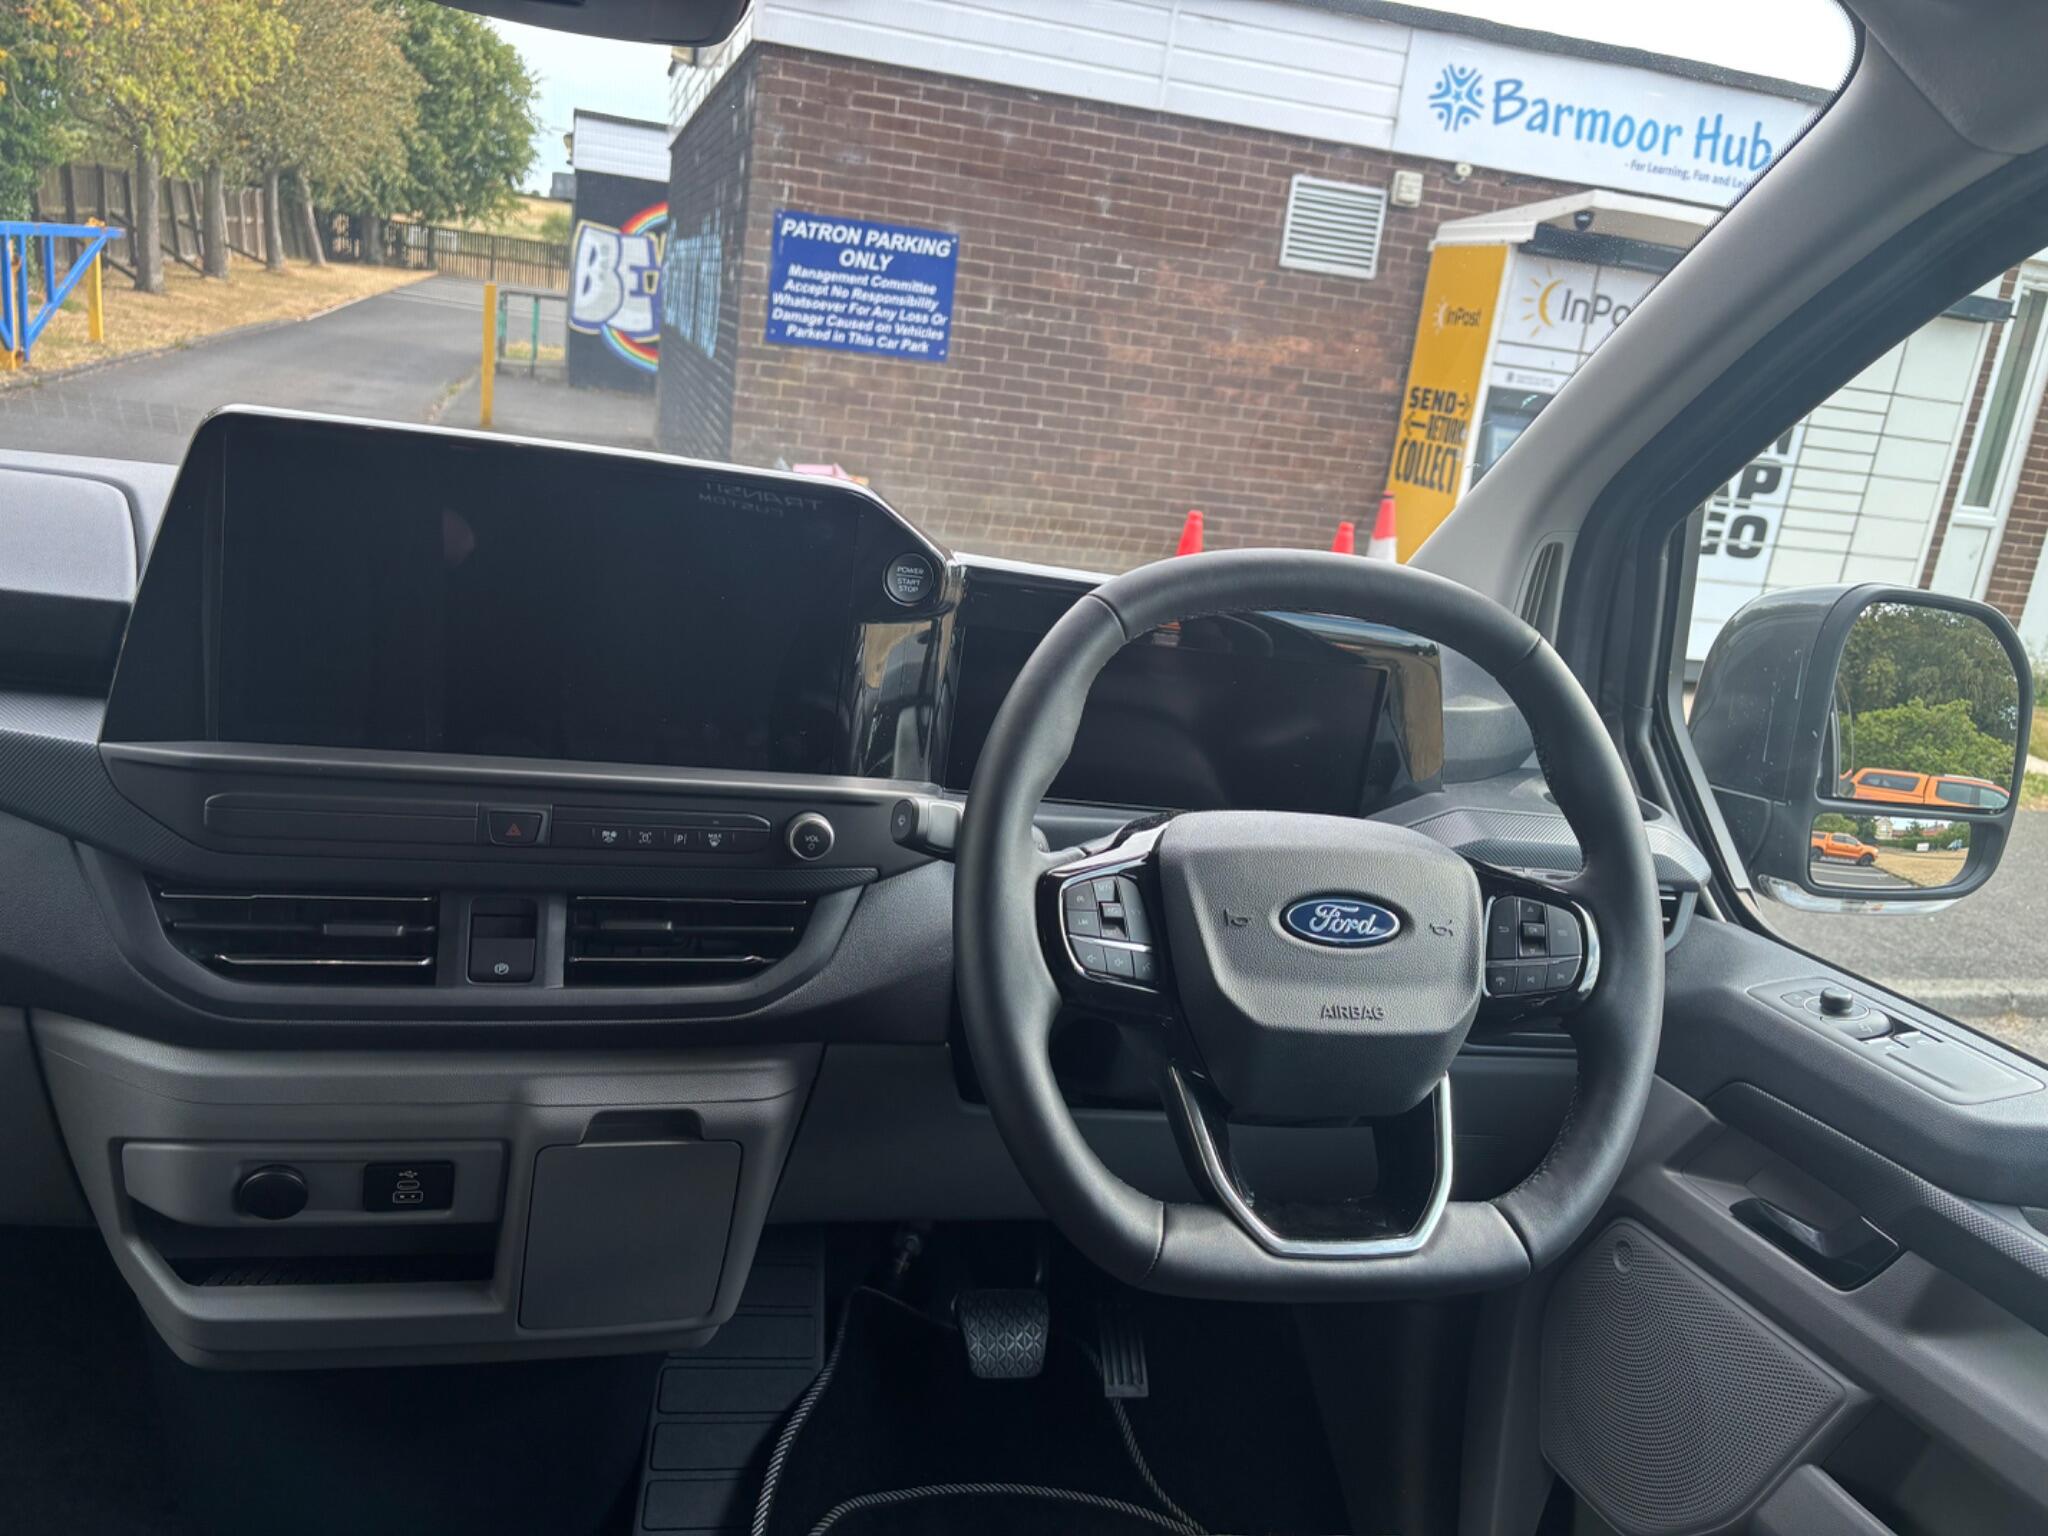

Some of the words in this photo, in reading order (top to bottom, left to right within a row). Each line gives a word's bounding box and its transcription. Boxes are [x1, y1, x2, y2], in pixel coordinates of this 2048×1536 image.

[1493, 78, 1683, 155] Barmoor
[1694, 113, 1773, 171] Hub
[1630, 159, 1646, 172] For
[1647, 163, 1690, 180] Learning,
[1693, 169, 1710, 183] Fun
[1711, 173, 1731, 187] and
[781, 218, 862, 246] PATRON
[864, 229, 952, 258] PARKING
[838, 249, 894, 272] ONLY
[787, 263, 869, 286] Management
[870, 274, 937, 295] Committee
[772, 292, 847, 313] Whatsoever
[848, 301, 870, 316] For
[871, 304, 897, 322] Any
[899, 309, 928, 324] Loss
[931, 313, 948, 327] Or
[783, 279, 829, 298] Accept
[830, 284, 849, 299] No
[851, 287, 939, 312] Responsibility
[1561, 288, 1631, 327] InPo
[771, 307, 824, 327] Damage
[826, 314, 873, 332] Caused
[875, 320, 891, 333] on
[894, 322, 945, 341] Vehicles
[1447, 306, 1483, 328] InPost
[786, 324, 830, 342] Parked
[832, 329, 845, 343] in
[849, 330, 874, 347] This
[876, 335, 899, 350] Car
[900, 337, 929, 353] Park
[1408, 386, 1457, 414] SEND
[1394, 438, 1458, 494] COLLECT
[897, 566, 924, 575] POWER
[897, 577, 920, 586] START
[898, 585, 919, 593] STOP
[1309, 904, 1387, 935] Ford
[1320, 1004, 1385, 1021] AIRBAG
